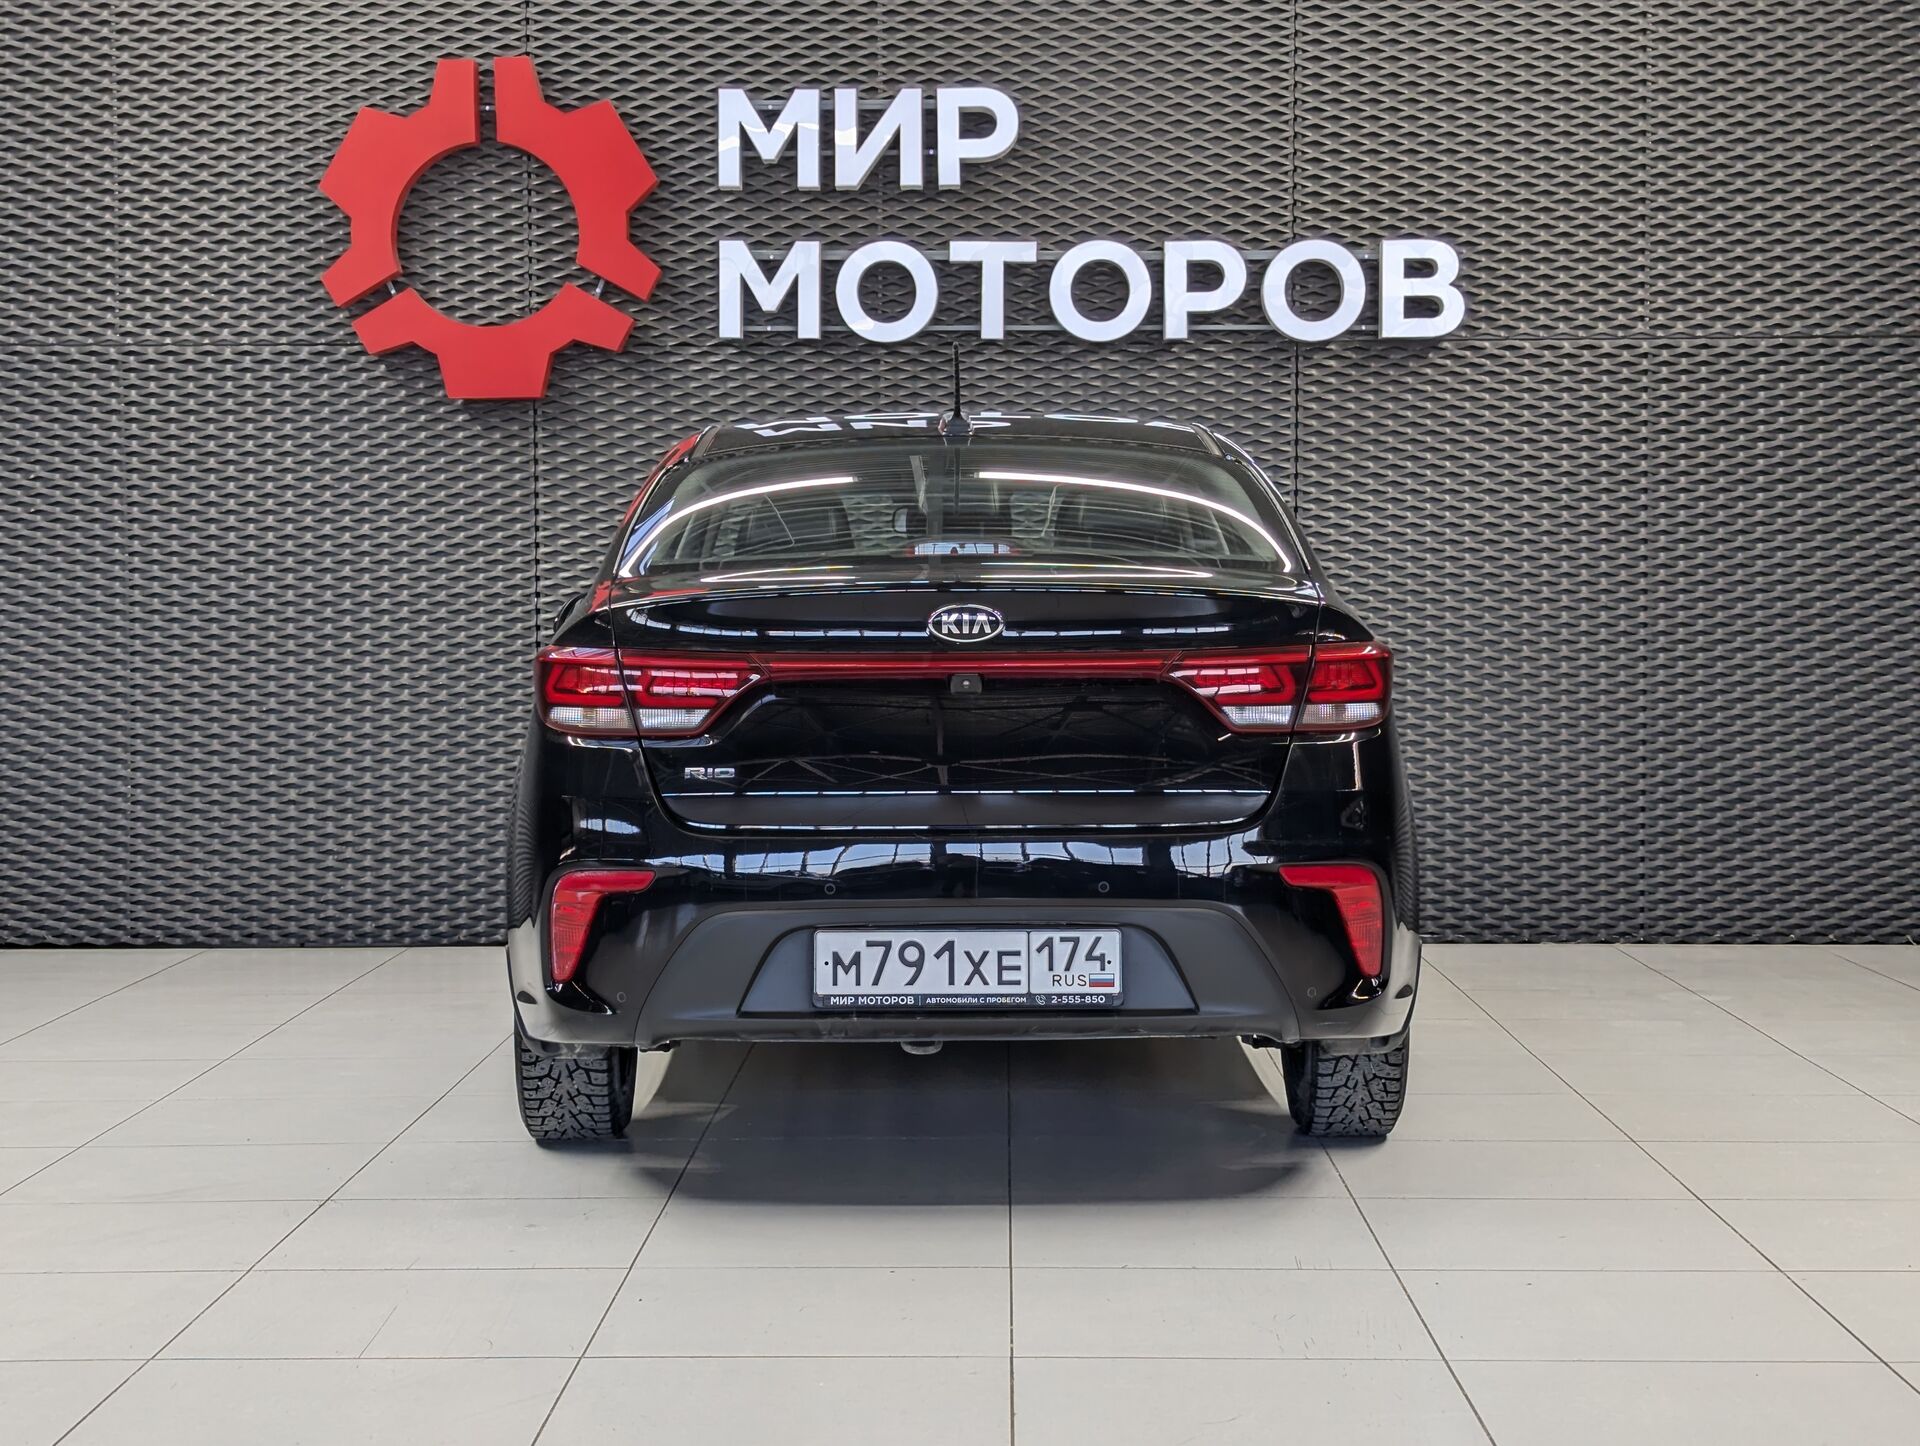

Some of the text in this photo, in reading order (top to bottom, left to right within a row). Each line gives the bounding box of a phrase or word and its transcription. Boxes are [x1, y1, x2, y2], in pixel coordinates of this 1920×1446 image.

[717, 87, 1019, 190] МИР
[717, 239, 1466, 342] МОТОРОВ
[941, 613, 992, 634] KIA
[684, 767, 735, 780] RIO
[1036, 936, 1106, 972] 174
[1052, 974, 1087, 988] RUS
[830, 995, 855, 1005] МИР
[858, 995, 914, 1005] МОТОРОВ
[986, 996, 1027, 1004] ПРОБЕГОМ
[1051, 995, 1106, 1004] 2-555-850
